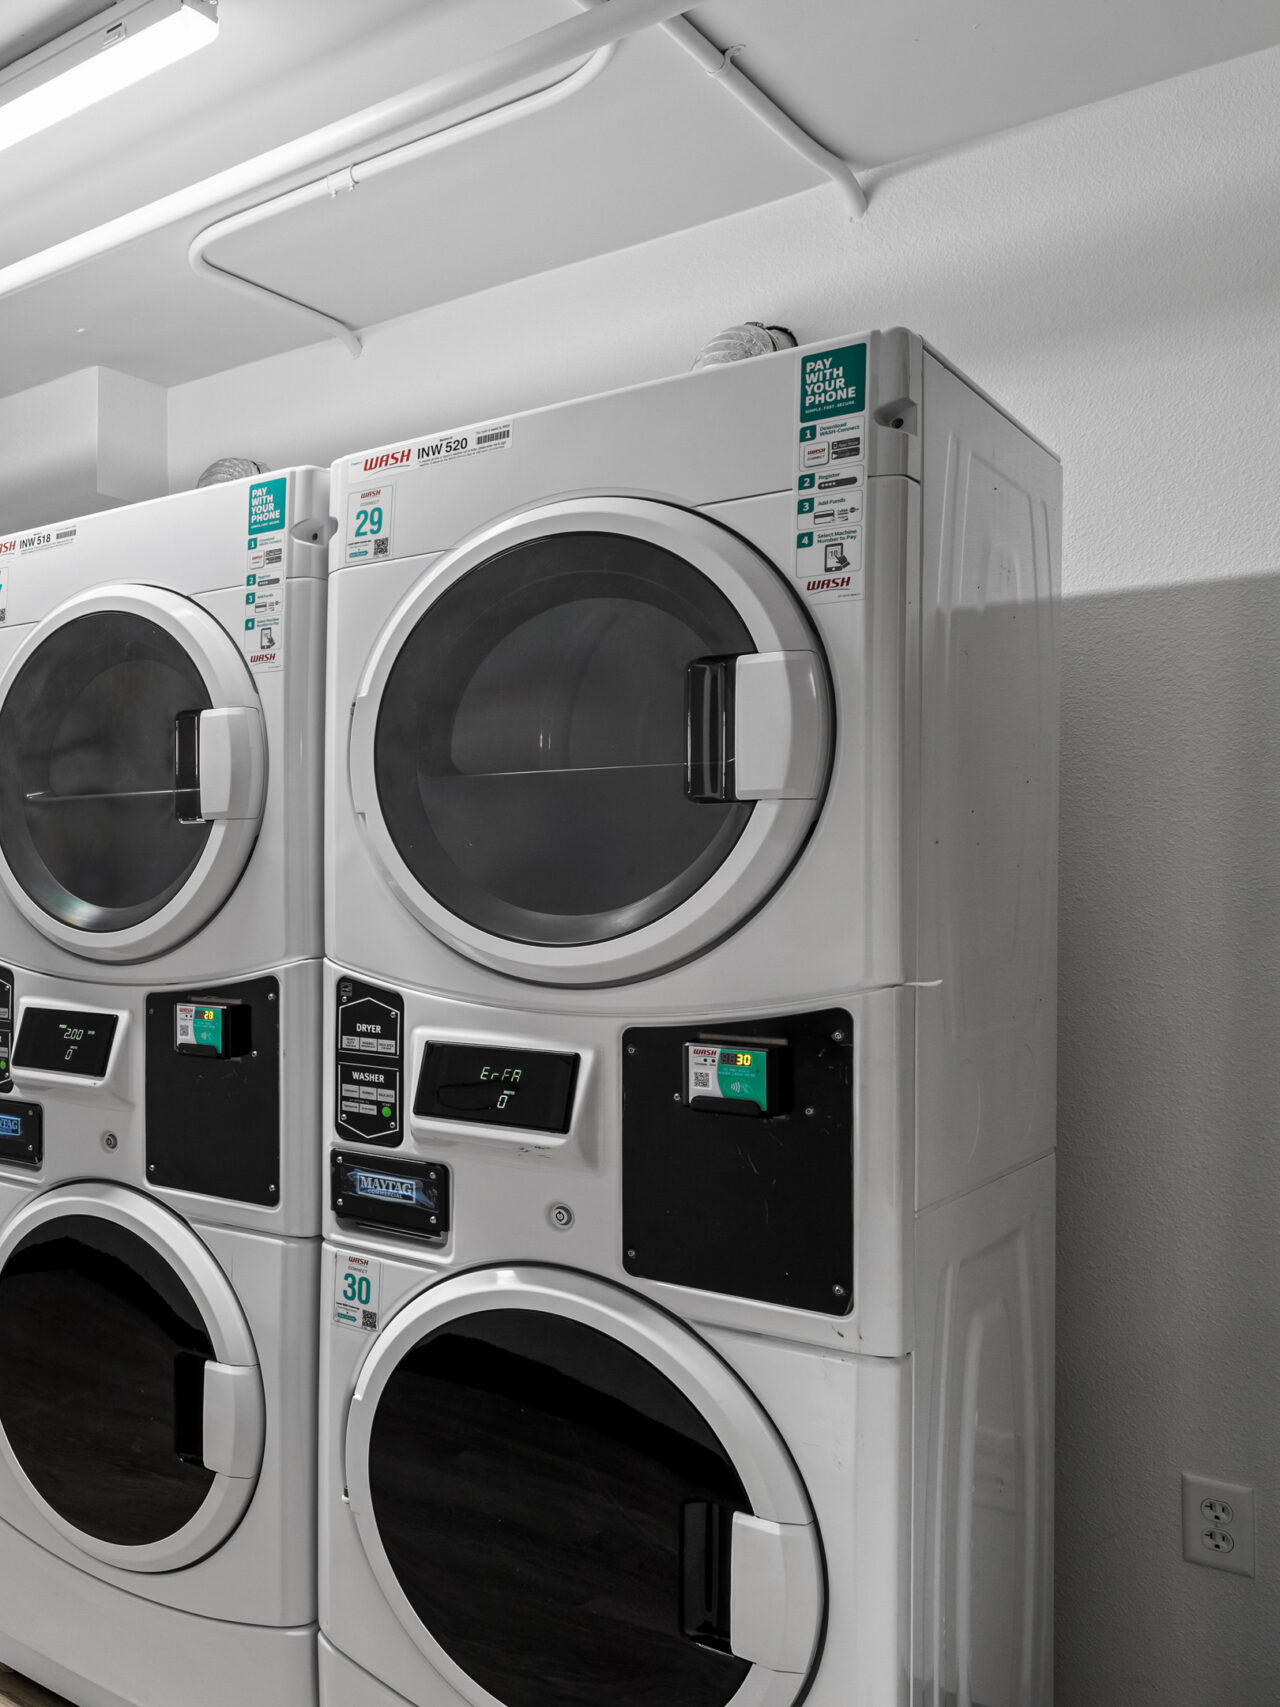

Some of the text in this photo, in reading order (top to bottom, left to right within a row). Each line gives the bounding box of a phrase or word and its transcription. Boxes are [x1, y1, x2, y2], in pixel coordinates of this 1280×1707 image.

[806, 358, 832, 372] PAY
[805, 366, 843, 384] WITH
[805, 378, 845, 395] YOUR
[805, 386, 856, 406] PHONE
[805, 430, 812, 439] 1
[363, 448, 412, 472] WASH
[417, 442, 443, 460] INW
[445, 438, 468, 454] 520
[804, 478, 810, 486] 2
[252, 486, 268, 498] PAY
[251, 494, 274, 506] WITH
[250, 502, 275, 514] YOUR
[802, 502, 810, 511] 3
[250, 510, 280, 524] PHONE
[354, 507, 383, 538] 29
[20, 536, 36, 550] INW
[36, 534, 51, 545] 518
[250, 540, 255, 548] 1
[802, 536, 808, 544] 4
[806, 576, 851, 591] WASH
[250, 653, 276, 663] WASH
[204, 1010, 214, 1020] 28
[64, 1028, 84, 1040] 2.00
[356, 1022, 382, 1034] DRYER
[693, 1048, 717, 1056] WASH
[736, 1054, 751, 1066] 30
[352, 1070, 384, 1084] WASHER
[360, 1176, 412, 1196] MAYTAG
[348, 1256, 369, 1266] WASH
[342, 1272, 371, 1306] 30
